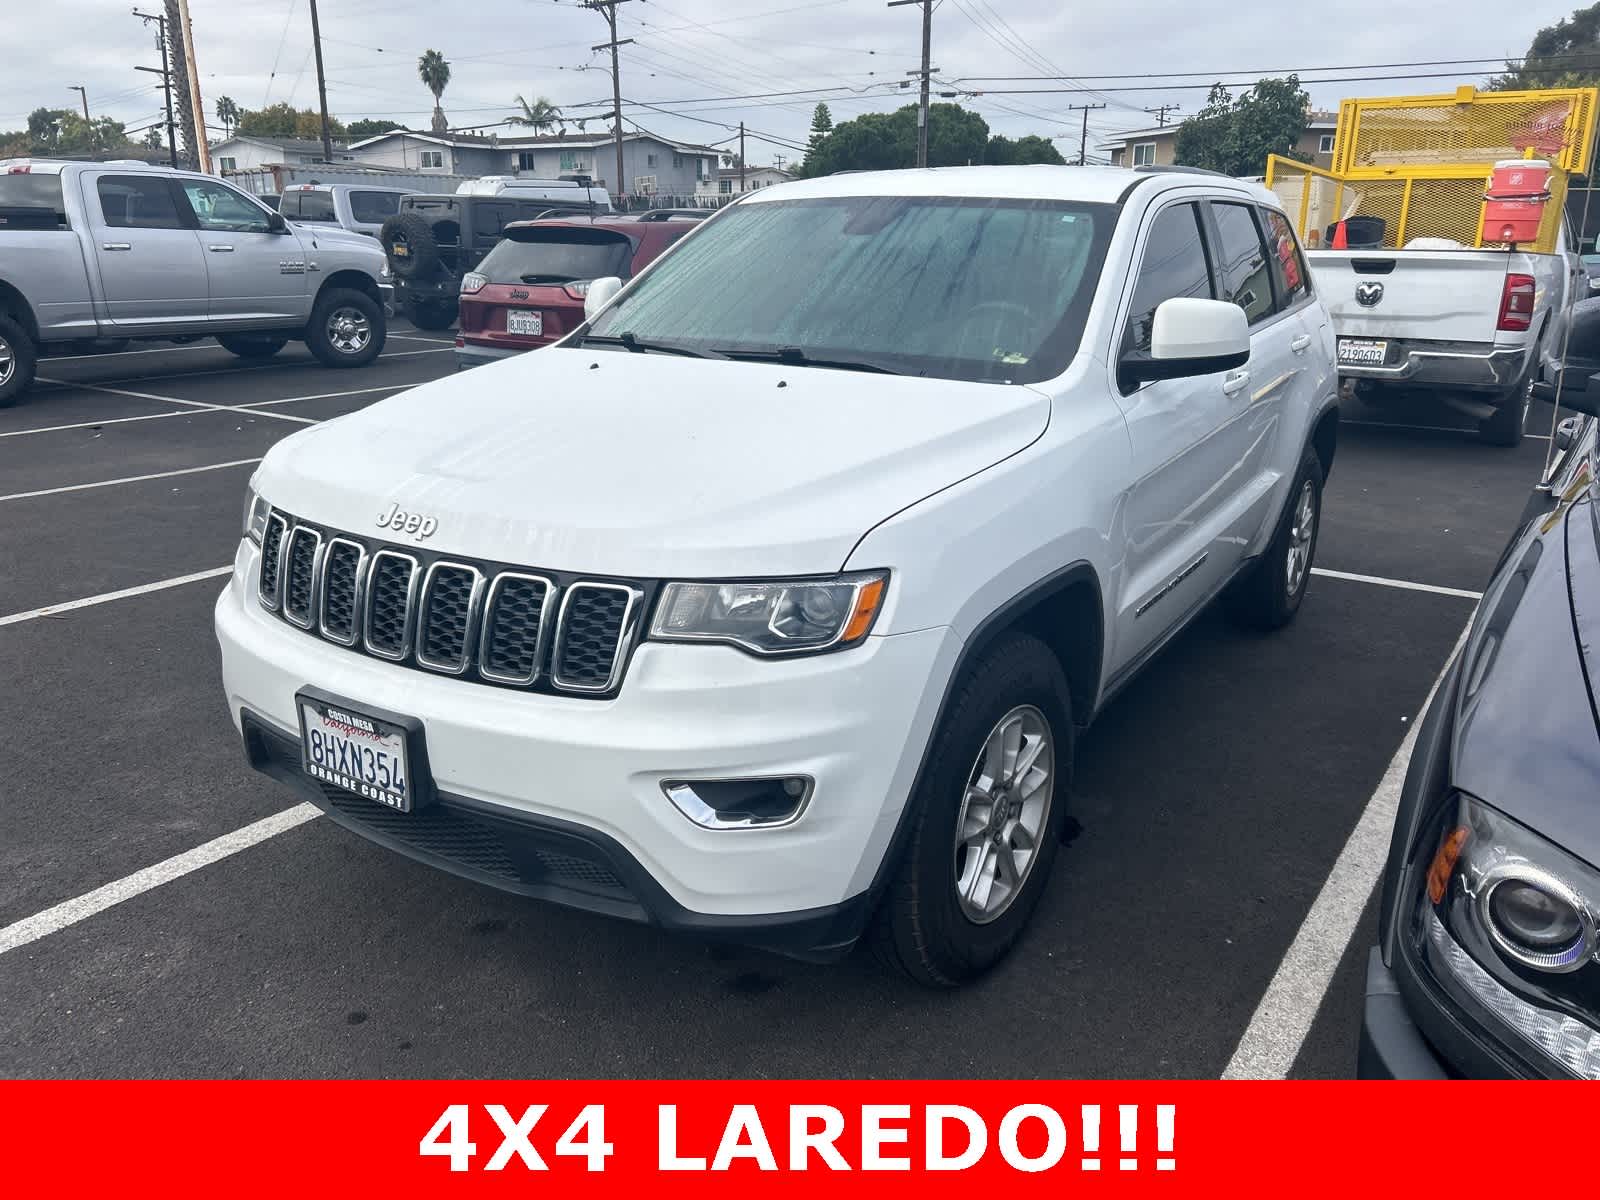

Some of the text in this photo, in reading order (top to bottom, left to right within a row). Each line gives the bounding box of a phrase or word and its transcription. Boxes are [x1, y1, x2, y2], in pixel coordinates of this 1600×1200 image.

[376, 502, 438, 541] Jeep
[328, 709, 374, 733] COSTA MESA
[311, 728, 405, 794] 8HXN354
[310, 764, 403, 808] ORANGE COAST
